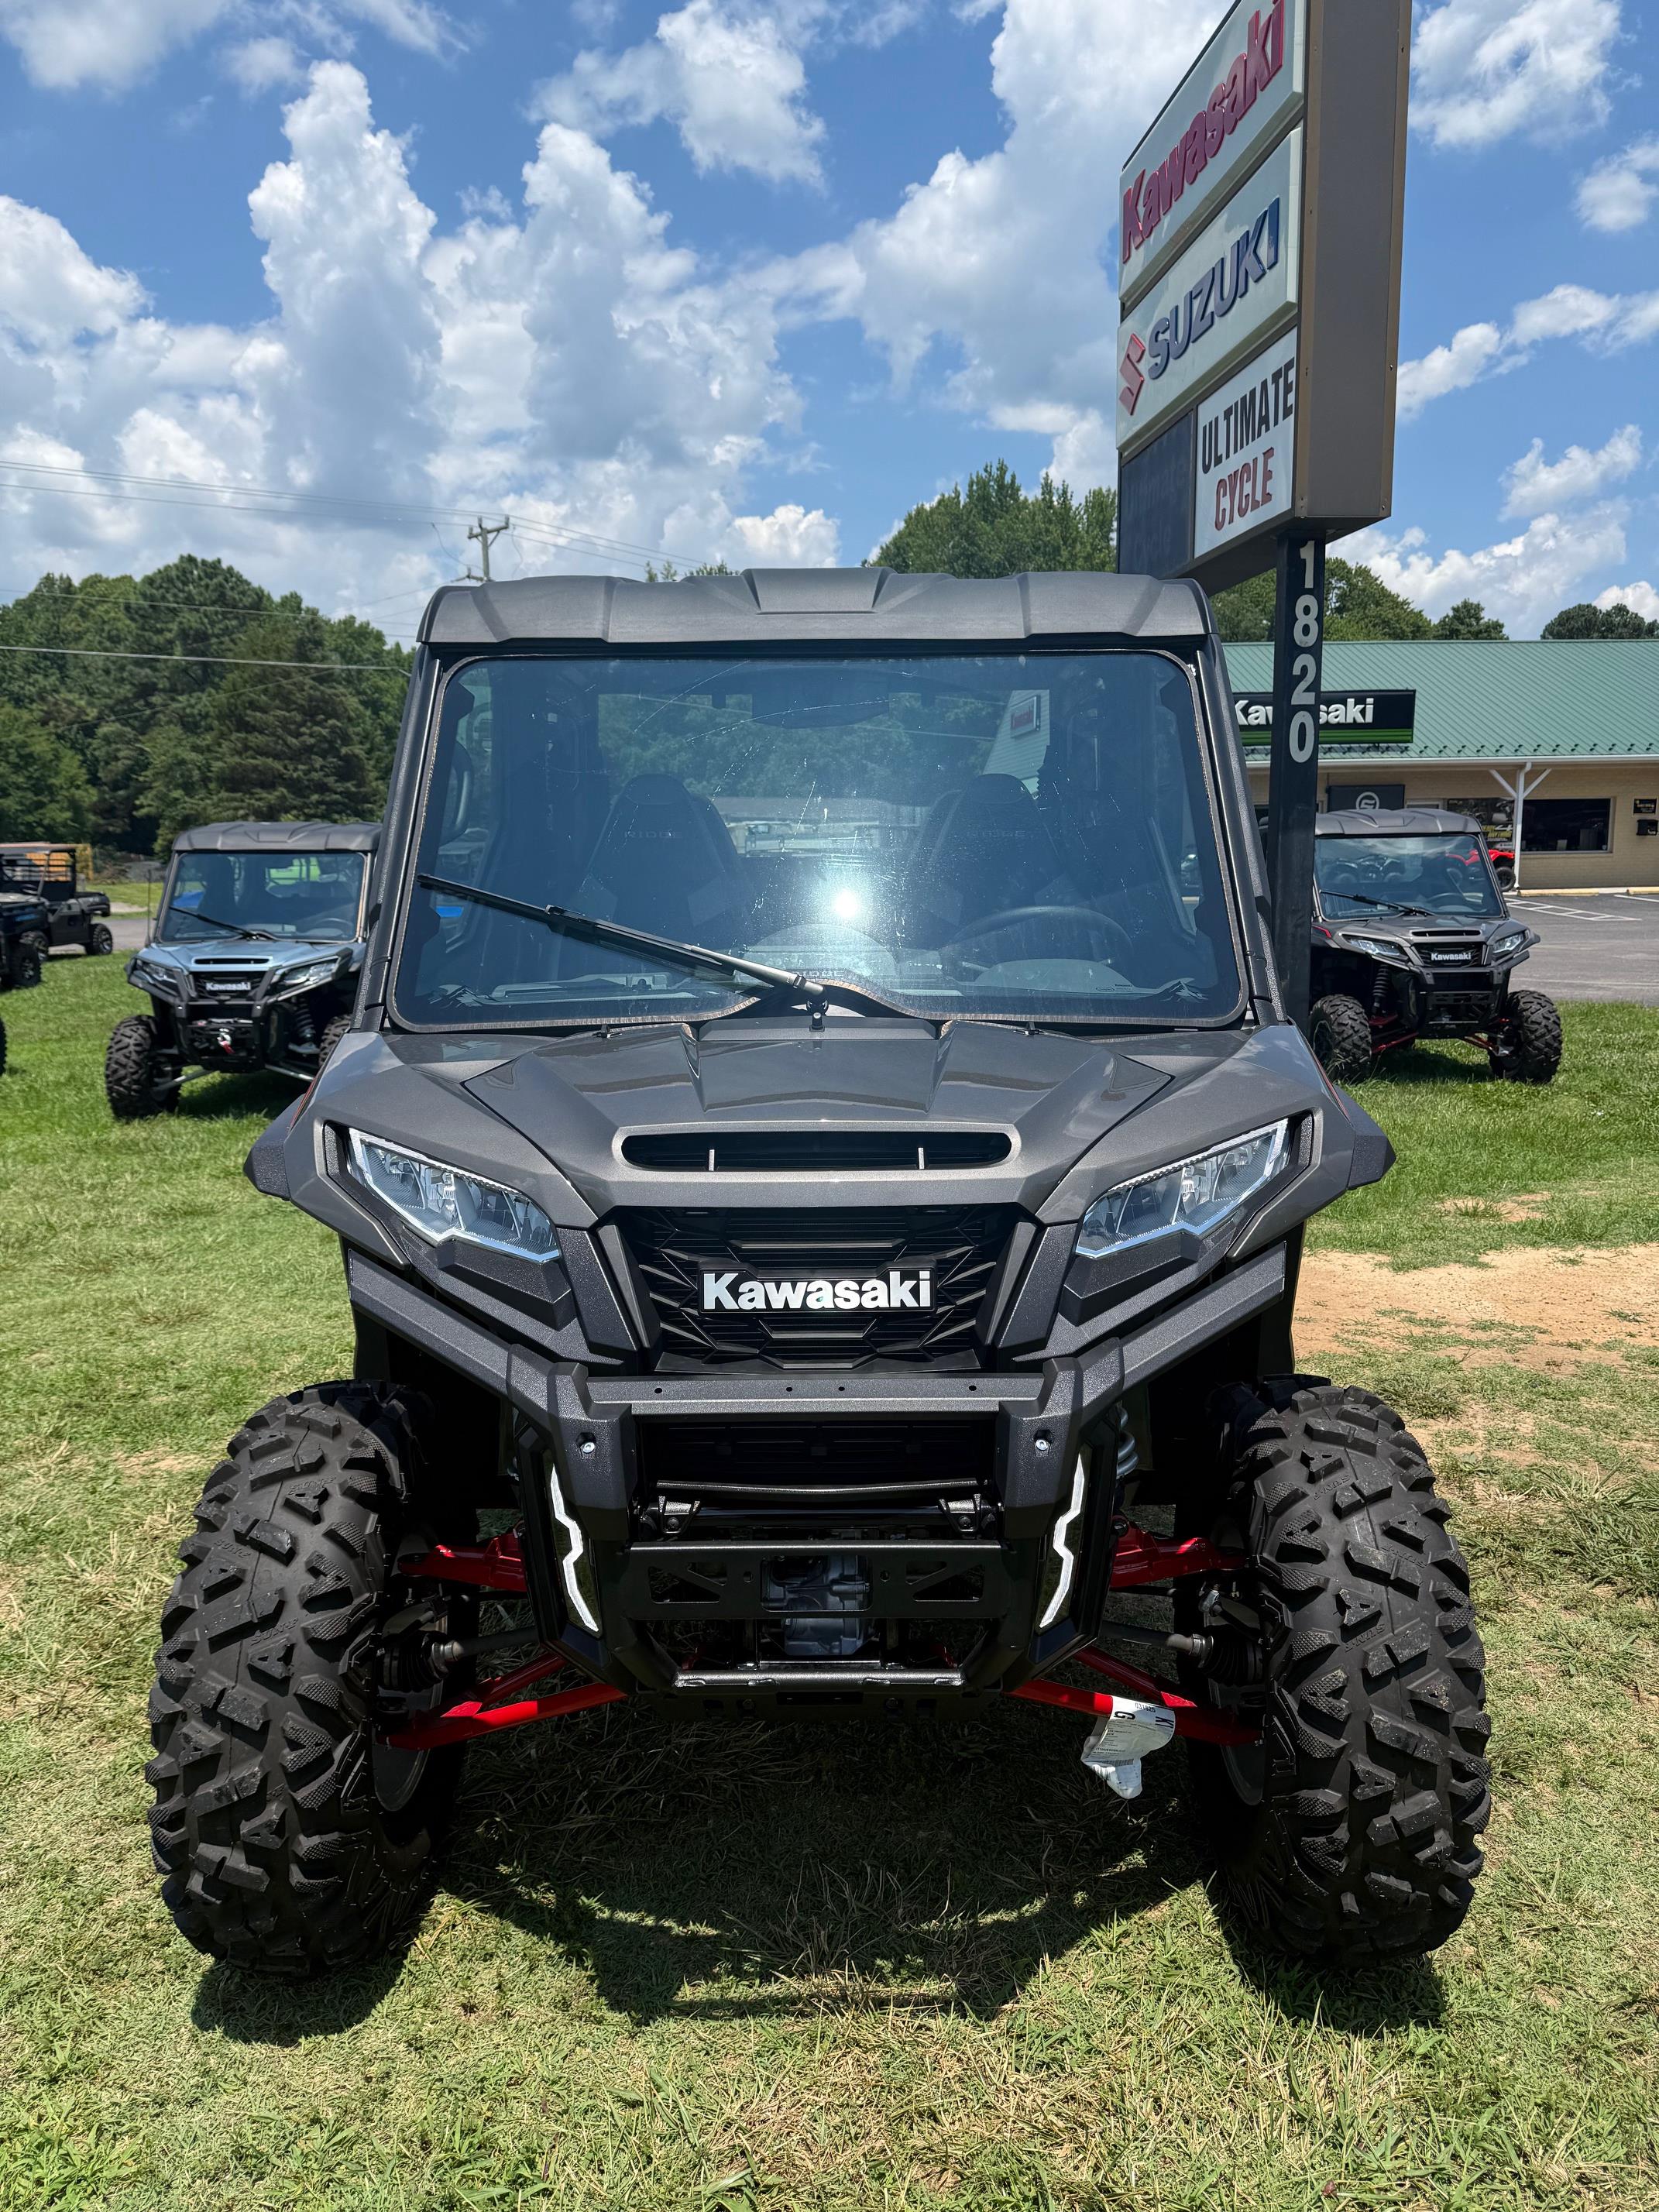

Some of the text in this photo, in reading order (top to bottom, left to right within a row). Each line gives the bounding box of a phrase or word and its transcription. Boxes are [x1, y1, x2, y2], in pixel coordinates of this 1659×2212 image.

[1123, 0, 1284, 264] Kawasaki
[1148, 196, 1280, 380] SUZUKI
[1201, 356, 1295, 474] ULTIMATE
[1214, 447, 1275, 531] CYCLE
[1235, 698, 1374, 726] Kaaki
[1431, 952, 1472, 960] Kawasaki
[703, 1270, 931, 1310] Kawasaki
